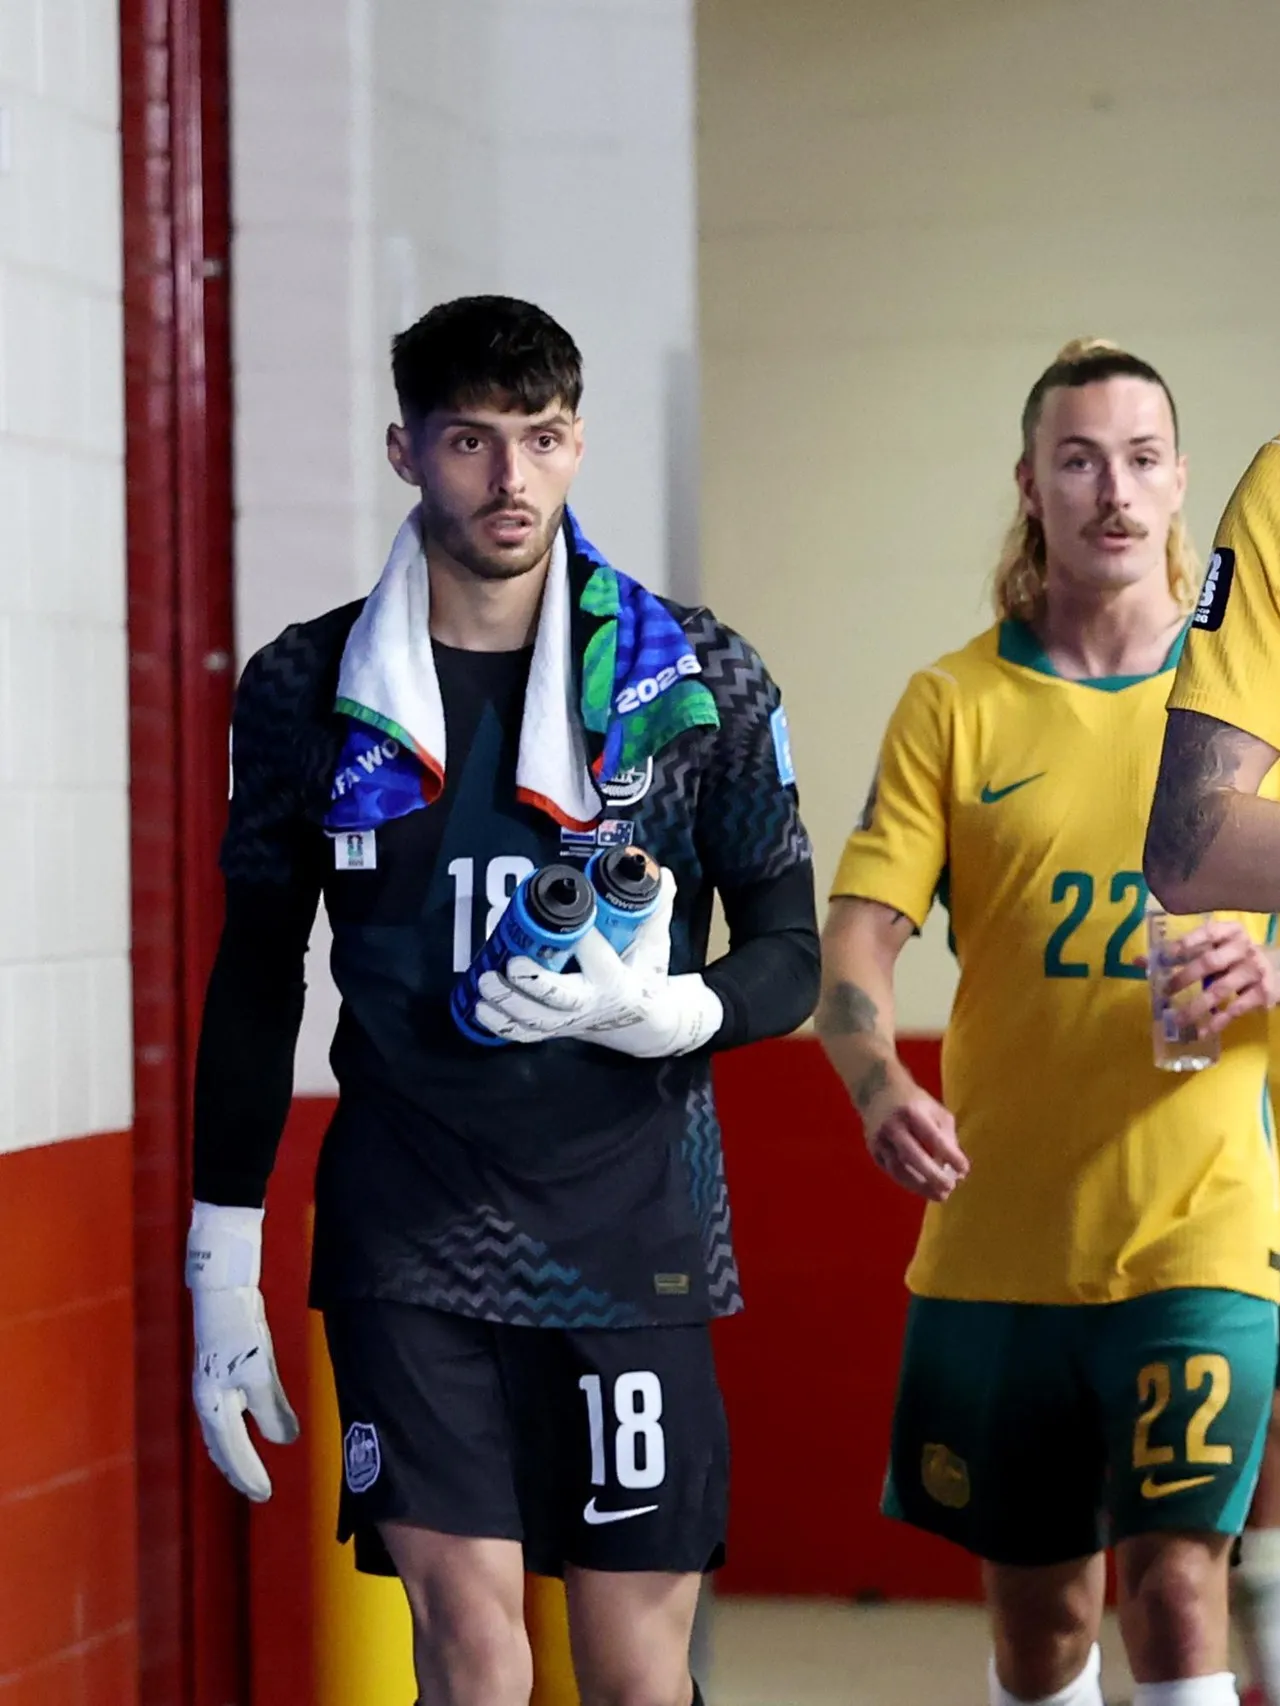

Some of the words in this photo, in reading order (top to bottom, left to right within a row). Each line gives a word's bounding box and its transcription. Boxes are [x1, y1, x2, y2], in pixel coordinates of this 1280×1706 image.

[615, 654, 702, 714] 2026
[1044, 871, 1150, 980] 22
[578, 1370, 666, 1490] 18
[1132, 1353, 1233, 1469] 22
